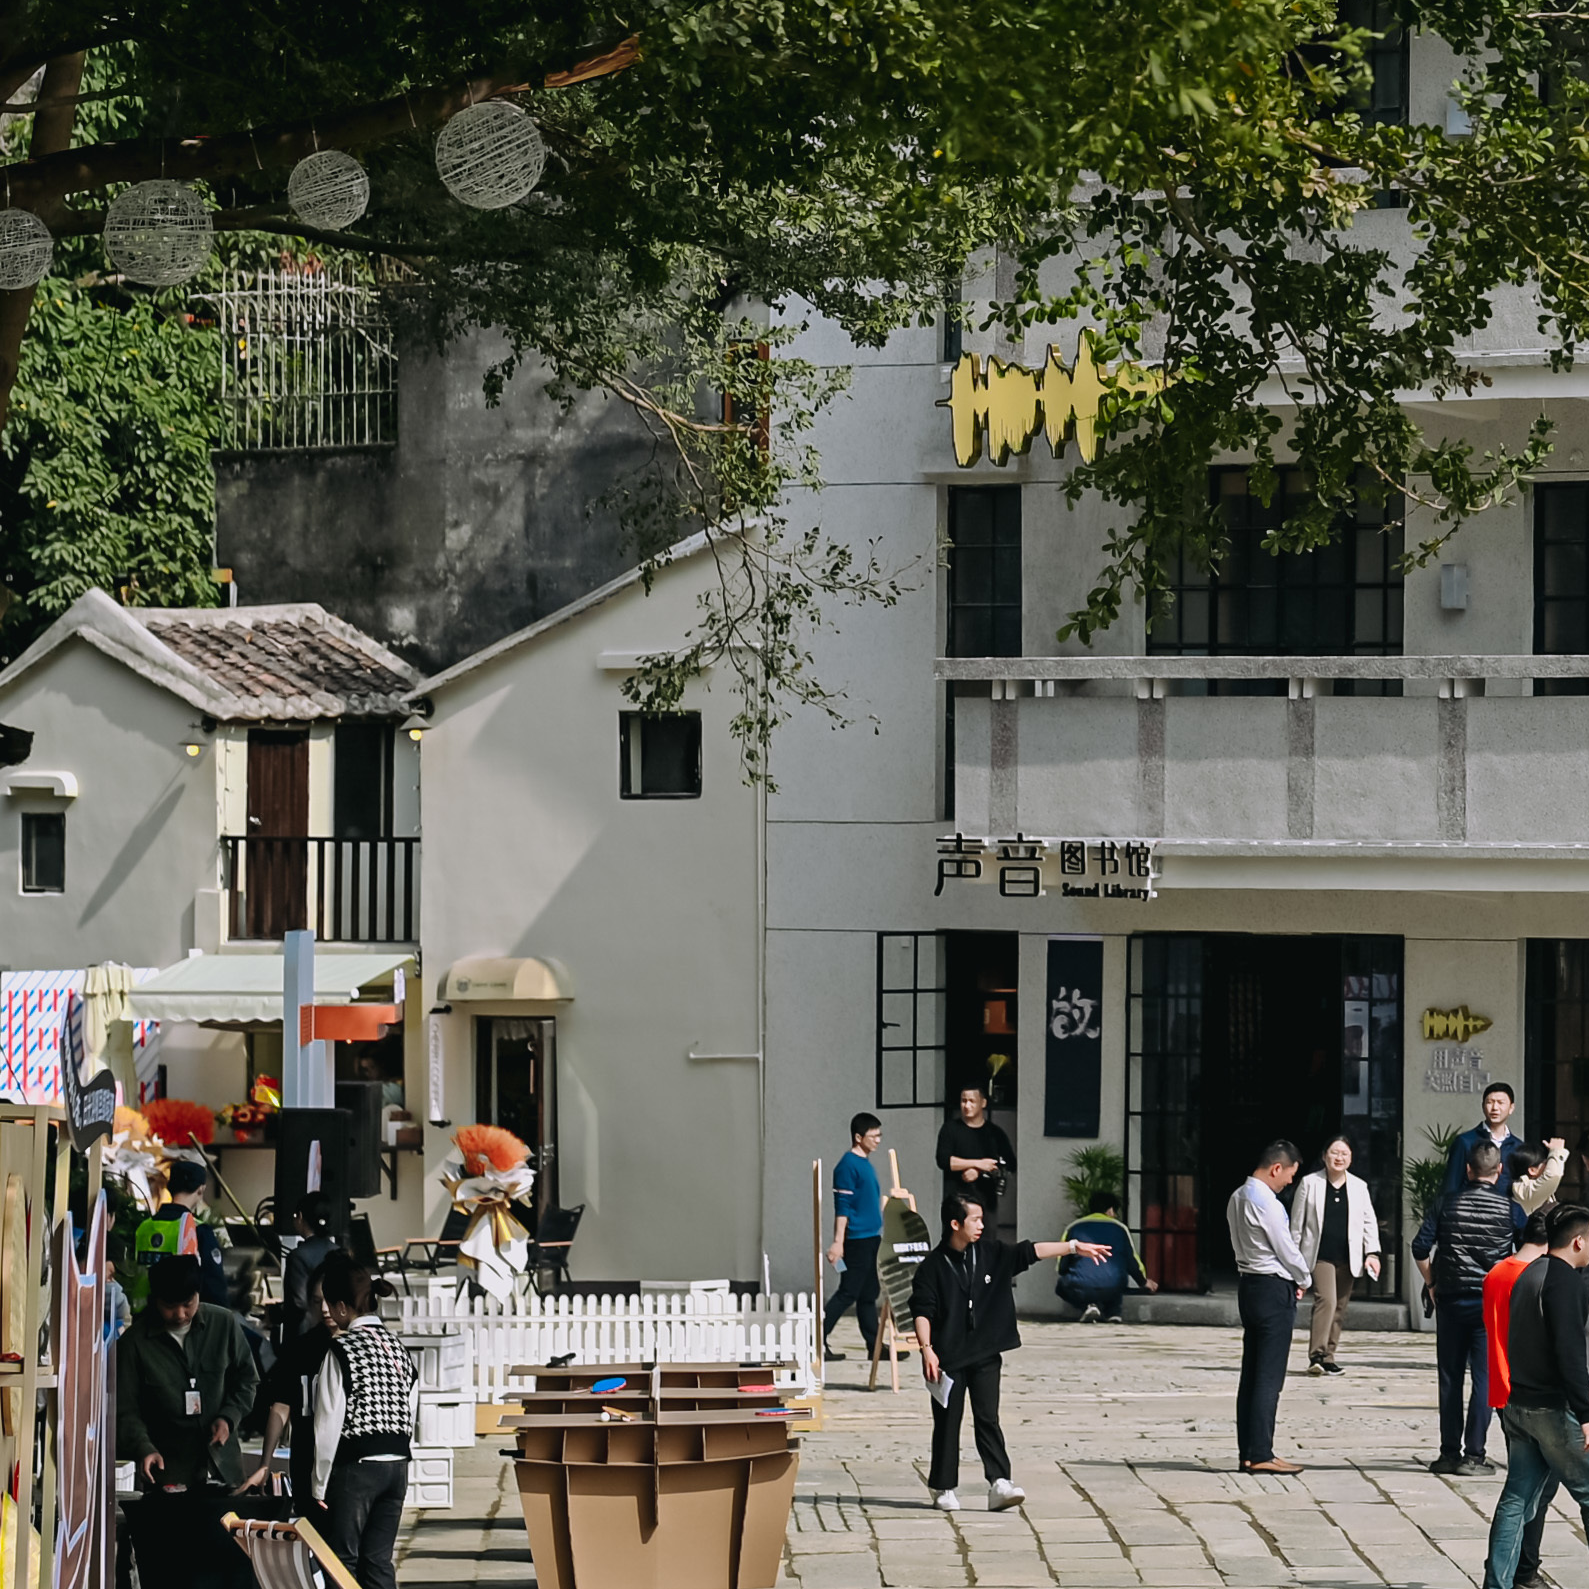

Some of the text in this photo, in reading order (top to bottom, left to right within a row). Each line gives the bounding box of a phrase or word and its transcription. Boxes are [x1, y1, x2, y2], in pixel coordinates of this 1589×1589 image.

[934, 832, 1150, 897] 声音 图书馆
[1062, 882, 1150, 902] Sound Library
